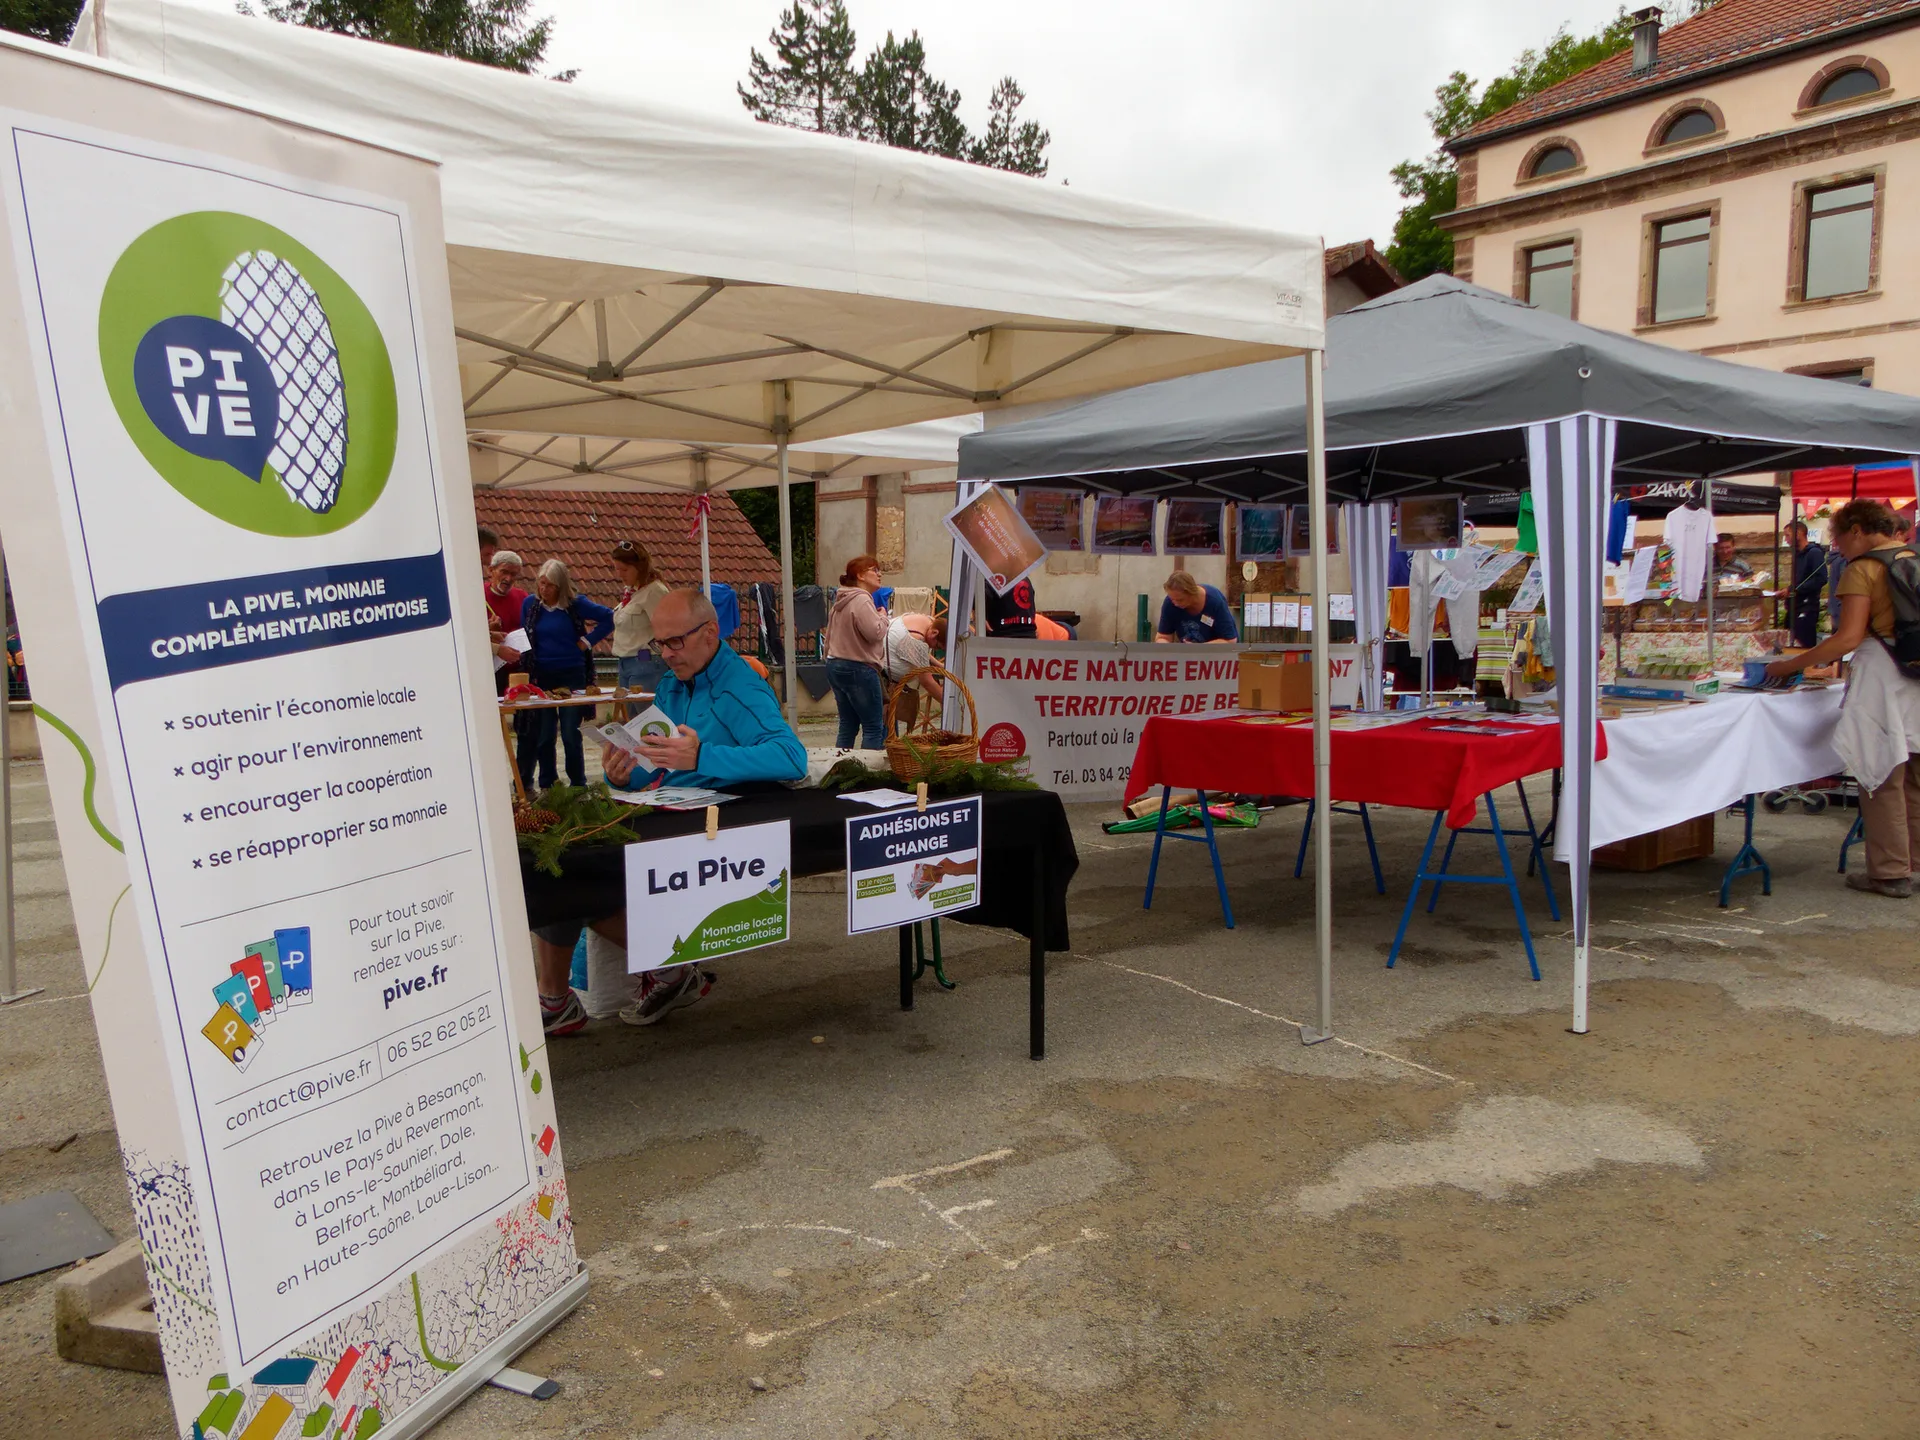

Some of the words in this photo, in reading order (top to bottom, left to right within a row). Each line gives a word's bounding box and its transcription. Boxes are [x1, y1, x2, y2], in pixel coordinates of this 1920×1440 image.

[209, 598, 241, 620] LA
[244, 591, 301, 615] PIVE,
[305, 579, 385, 606] MONNAIE
[151, 609, 351, 659] COMPLÉMENTAIRE
[352, 598, 429, 625] COMTOISE
[976, 656, 1078, 683] FRANCE
[1085, 659, 1178, 683] NATURE
[182, 703, 272, 730] soutenir
[376, 686, 416, 706] locale
[1035, 695, 1174, 718] TERRITOIRE
[1179, 694, 1207, 714] DE
[1048, 729, 1098, 748] Partout
[1101, 727, 1119, 745] où
[1122, 728, 1134, 744] la
[191, 755, 232, 781] agir
[238, 746, 288, 774] pour
[1053, 767, 1078, 785] Tél.
[1082, 768, 1097, 783] 03
[1100, 767, 1113, 782] 84
[1117, 766, 1131, 781] 29
[200, 785, 322, 822] encourager
[326, 781, 343, 798] la
[346, 765, 432, 795] coopération
[209, 848, 232, 868] se
[236, 821, 365, 862] réapproprier
[369, 817, 389, 833] sa
[392, 801, 448, 827] monnaie
[859, 812, 950, 841] ADHÉSIONS
[953, 807, 971, 824] ET
[885, 834, 948, 859] CHANGE
[648, 867, 688, 895] La
[699, 856, 766, 887] Pive
[873, 875, 894, 884] rejoins
[937, 890, 943, 898] je
[944, 887, 963, 896] change
[349, 908, 383, 935] Pour
[386, 902, 418, 925] tout
[421, 889, 455, 913] savoir
[957, 894, 970, 903] pives
[371, 933, 395, 953] sur
[397, 928, 411, 944] la
[700, 925, 783, 952] franc-comtoise
[702, 922, 750, 939] Monnaie
[753, 913, 783, 930] locale
[353, 956, 401, 983] rendez
[404, 945, 439, 963] vous
[440, 937, 458, 953] sur
[295, 988, 309, 997] 20
[382, 965, 449, 1009] pive.fr
[253, 1017, 260, 1027] 2
[226, 1058, 373, 1132] contact@pive.fr
[387, 1043, 408, 1064] 06
[411, 1033, 433, 1053] 52
[436, 1021, 457, 1043] 62
[460, 1012, 477, 1032] 05
[478, 1005, 491, 1022] 21
[259, 1136, 354, 1188] Retrouvez
[357, 1127, 372, 1145] la
[375, 1112, 402, 1136] Pive
[405, 1102, 415, 1119] à
[417, 1070, 487, 1114] Besançon,
[273, 1181, 320, 1210] dans
[325, 1169, 341, 1188] le
[346, 1150, 384, 1177] Pays
[386, 1137, 403, 1155] du
[405, 1095, 484, 1140] Revermont,
[295, 1211, 308, 1229] à
[311, 1145, 438, 1220] Lons-le-Saunier,
[440, 1124, 476, 1150] Dole,
[315, 1202, 381, 1246] Belfort,
[381, 1152, 466, 1205] Montbéliard,
[276, 1274, 299, 1296] en
[303, 1210, 415, 1281] Haute-Saône,
